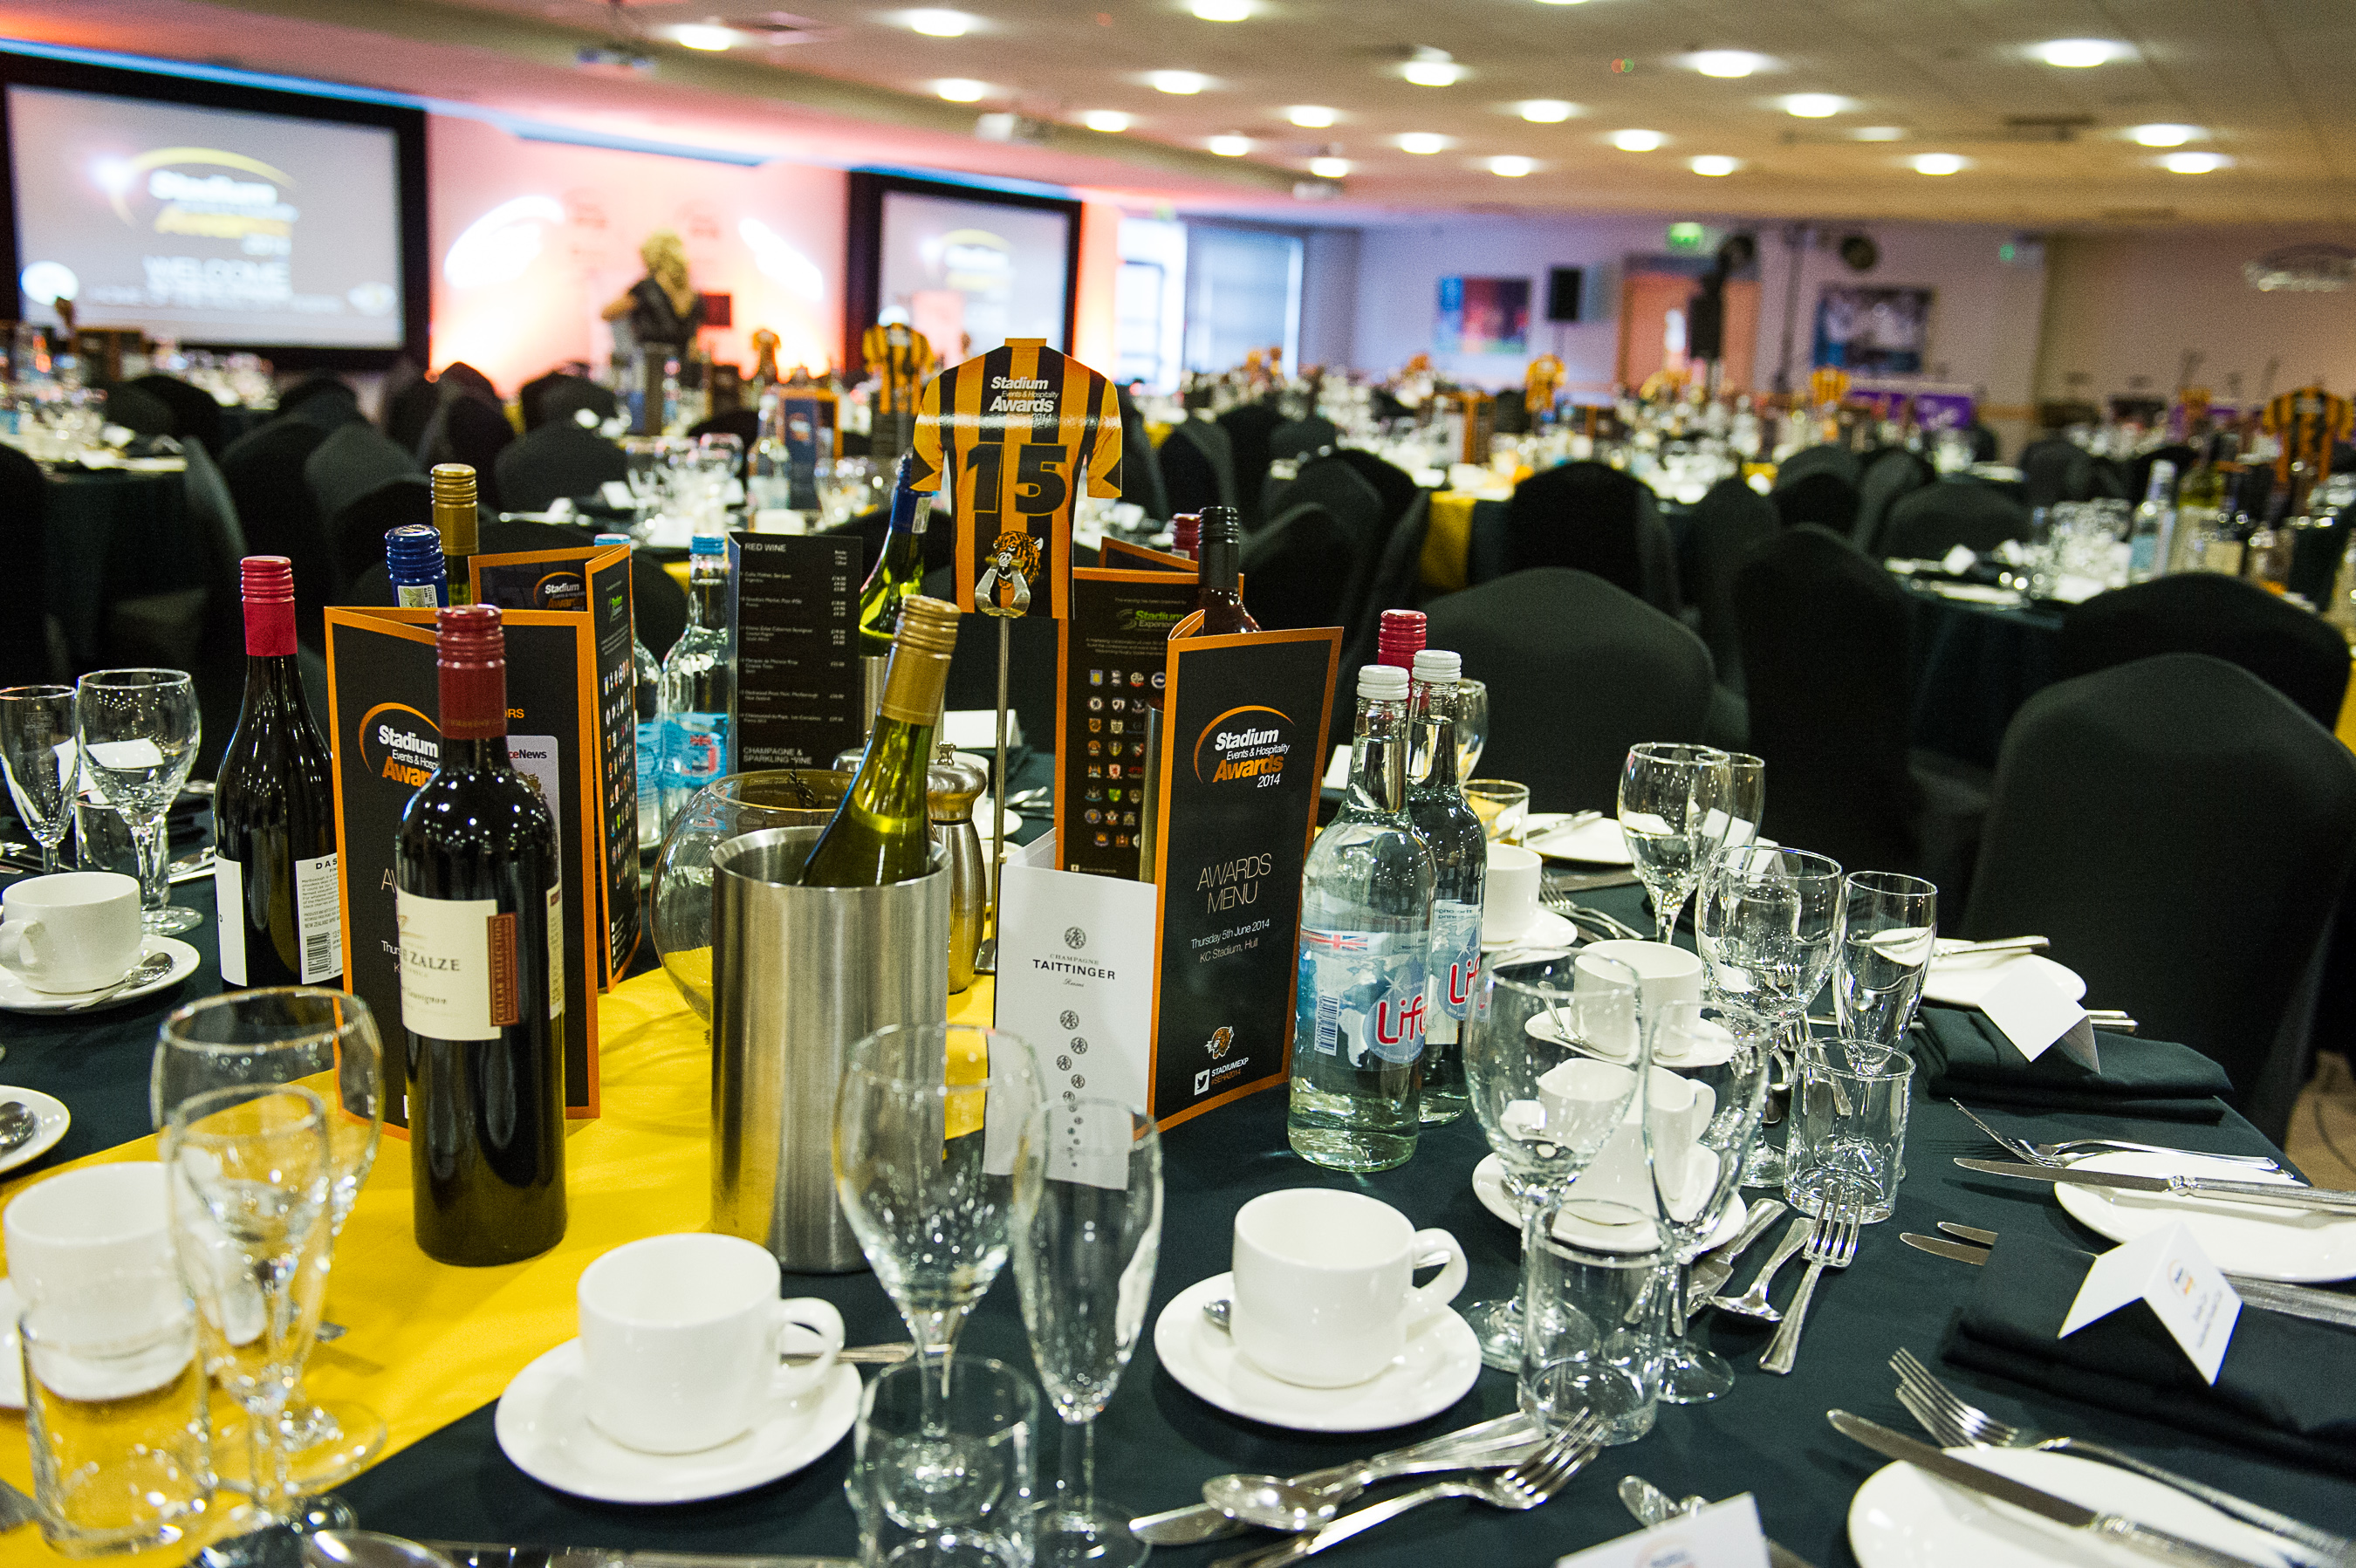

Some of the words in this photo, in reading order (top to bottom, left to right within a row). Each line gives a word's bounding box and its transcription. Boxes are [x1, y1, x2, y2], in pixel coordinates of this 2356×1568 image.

[990, 375, 1049, 390] Stadium
[989, 395, 1055, 413] Awards
[1028, 390, 1059, 401] Hospitality
[966, 442, 1068, 517] 15
[744, 543, 764, 551] RED
[764, 544, 786, 552] WINE
[545, 582, 580, 595] Stadium
[1135, 610, 1184, 621] Stadium
[1139, 620, 1175, 629] Experien
[378, 724, 439, 758] Stadium
[1215, 728, 1279, 750] Stadium
[392, 749, 414, 764] Events
[414, 755, 419, 765] &
[743, 747, 795, 757] CHAMPAGNE
[743, 754, 790, 763] SPARKLING
[1226, 750, 1249, 761] Events
[1249, 748, 1255, 757] &
[1256, 743, 1291, 757] Hospitality
[382, 756, 433, 787] Awar
[1212, 754, 1284, 784] Awards
[1257, 773, 1281, 788] 2014
[315, 859, 338, 870] DAS
[1196, 852, 1272, 892] AWARDS
[1207, 880, 1258, 914] MENU
[1190, 933, 1222, 949] Thursday
[1222, 928, 1234, 941] 5th
[1234, 925, 1251, 938] June
[1251, 918, 1270, 932] 2014
[381, 940, 401, 955] Thur
[1199, 950, 1212, 963] KC
[1244, 937, 1259, 949] Hull
[410, 950, 461, 972] ZALZE
[1049, 953, 1099, 966] CHAMPAGNE
[1032, 959, 1116, 981] TAITTINGER
[1449, 955, 1481, 1004] Lif
[1211, 1057, 1250, 1078] STADIUMEXP
